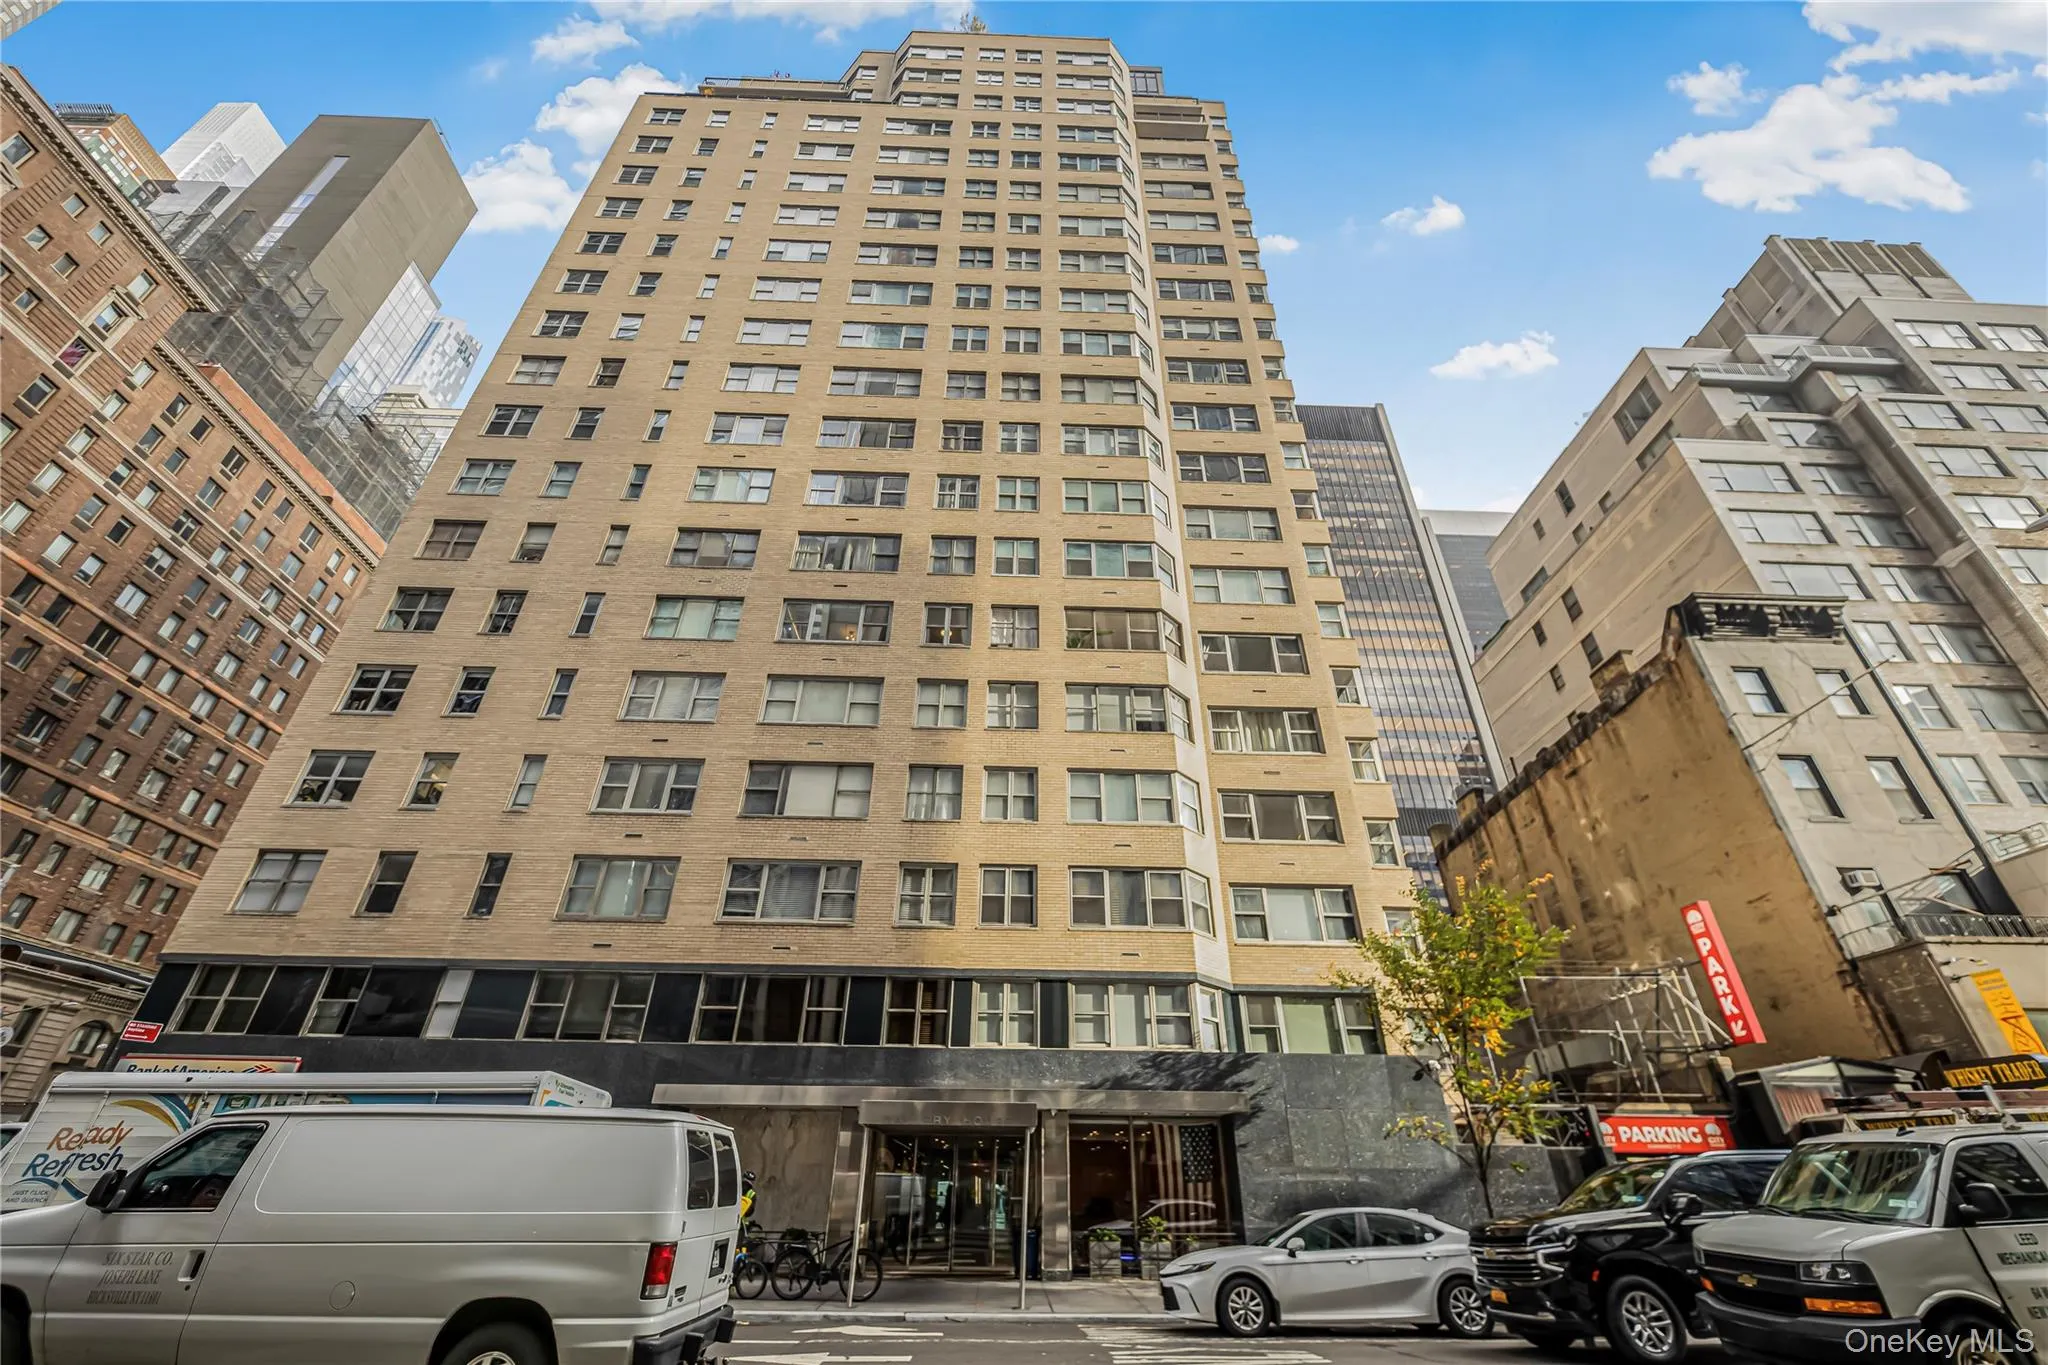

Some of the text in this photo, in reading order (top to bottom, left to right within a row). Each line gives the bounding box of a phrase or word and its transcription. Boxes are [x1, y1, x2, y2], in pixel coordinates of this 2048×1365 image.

[1696, 937, 1740, 1016] PARK
[1944, 1060, 2047, 1088] WHISKEY TRADER
[46, 1120, 134, 1151] Ready
[1617, 1126, 1703, 1143] PARKING
[21, 1145, 125, 1178] Refresh
[122, 1251, 155, 1266] STAR
[154, 1251, 174, 1266] CO.
[1996, 1250, 2048, 1266] MECHANICA
